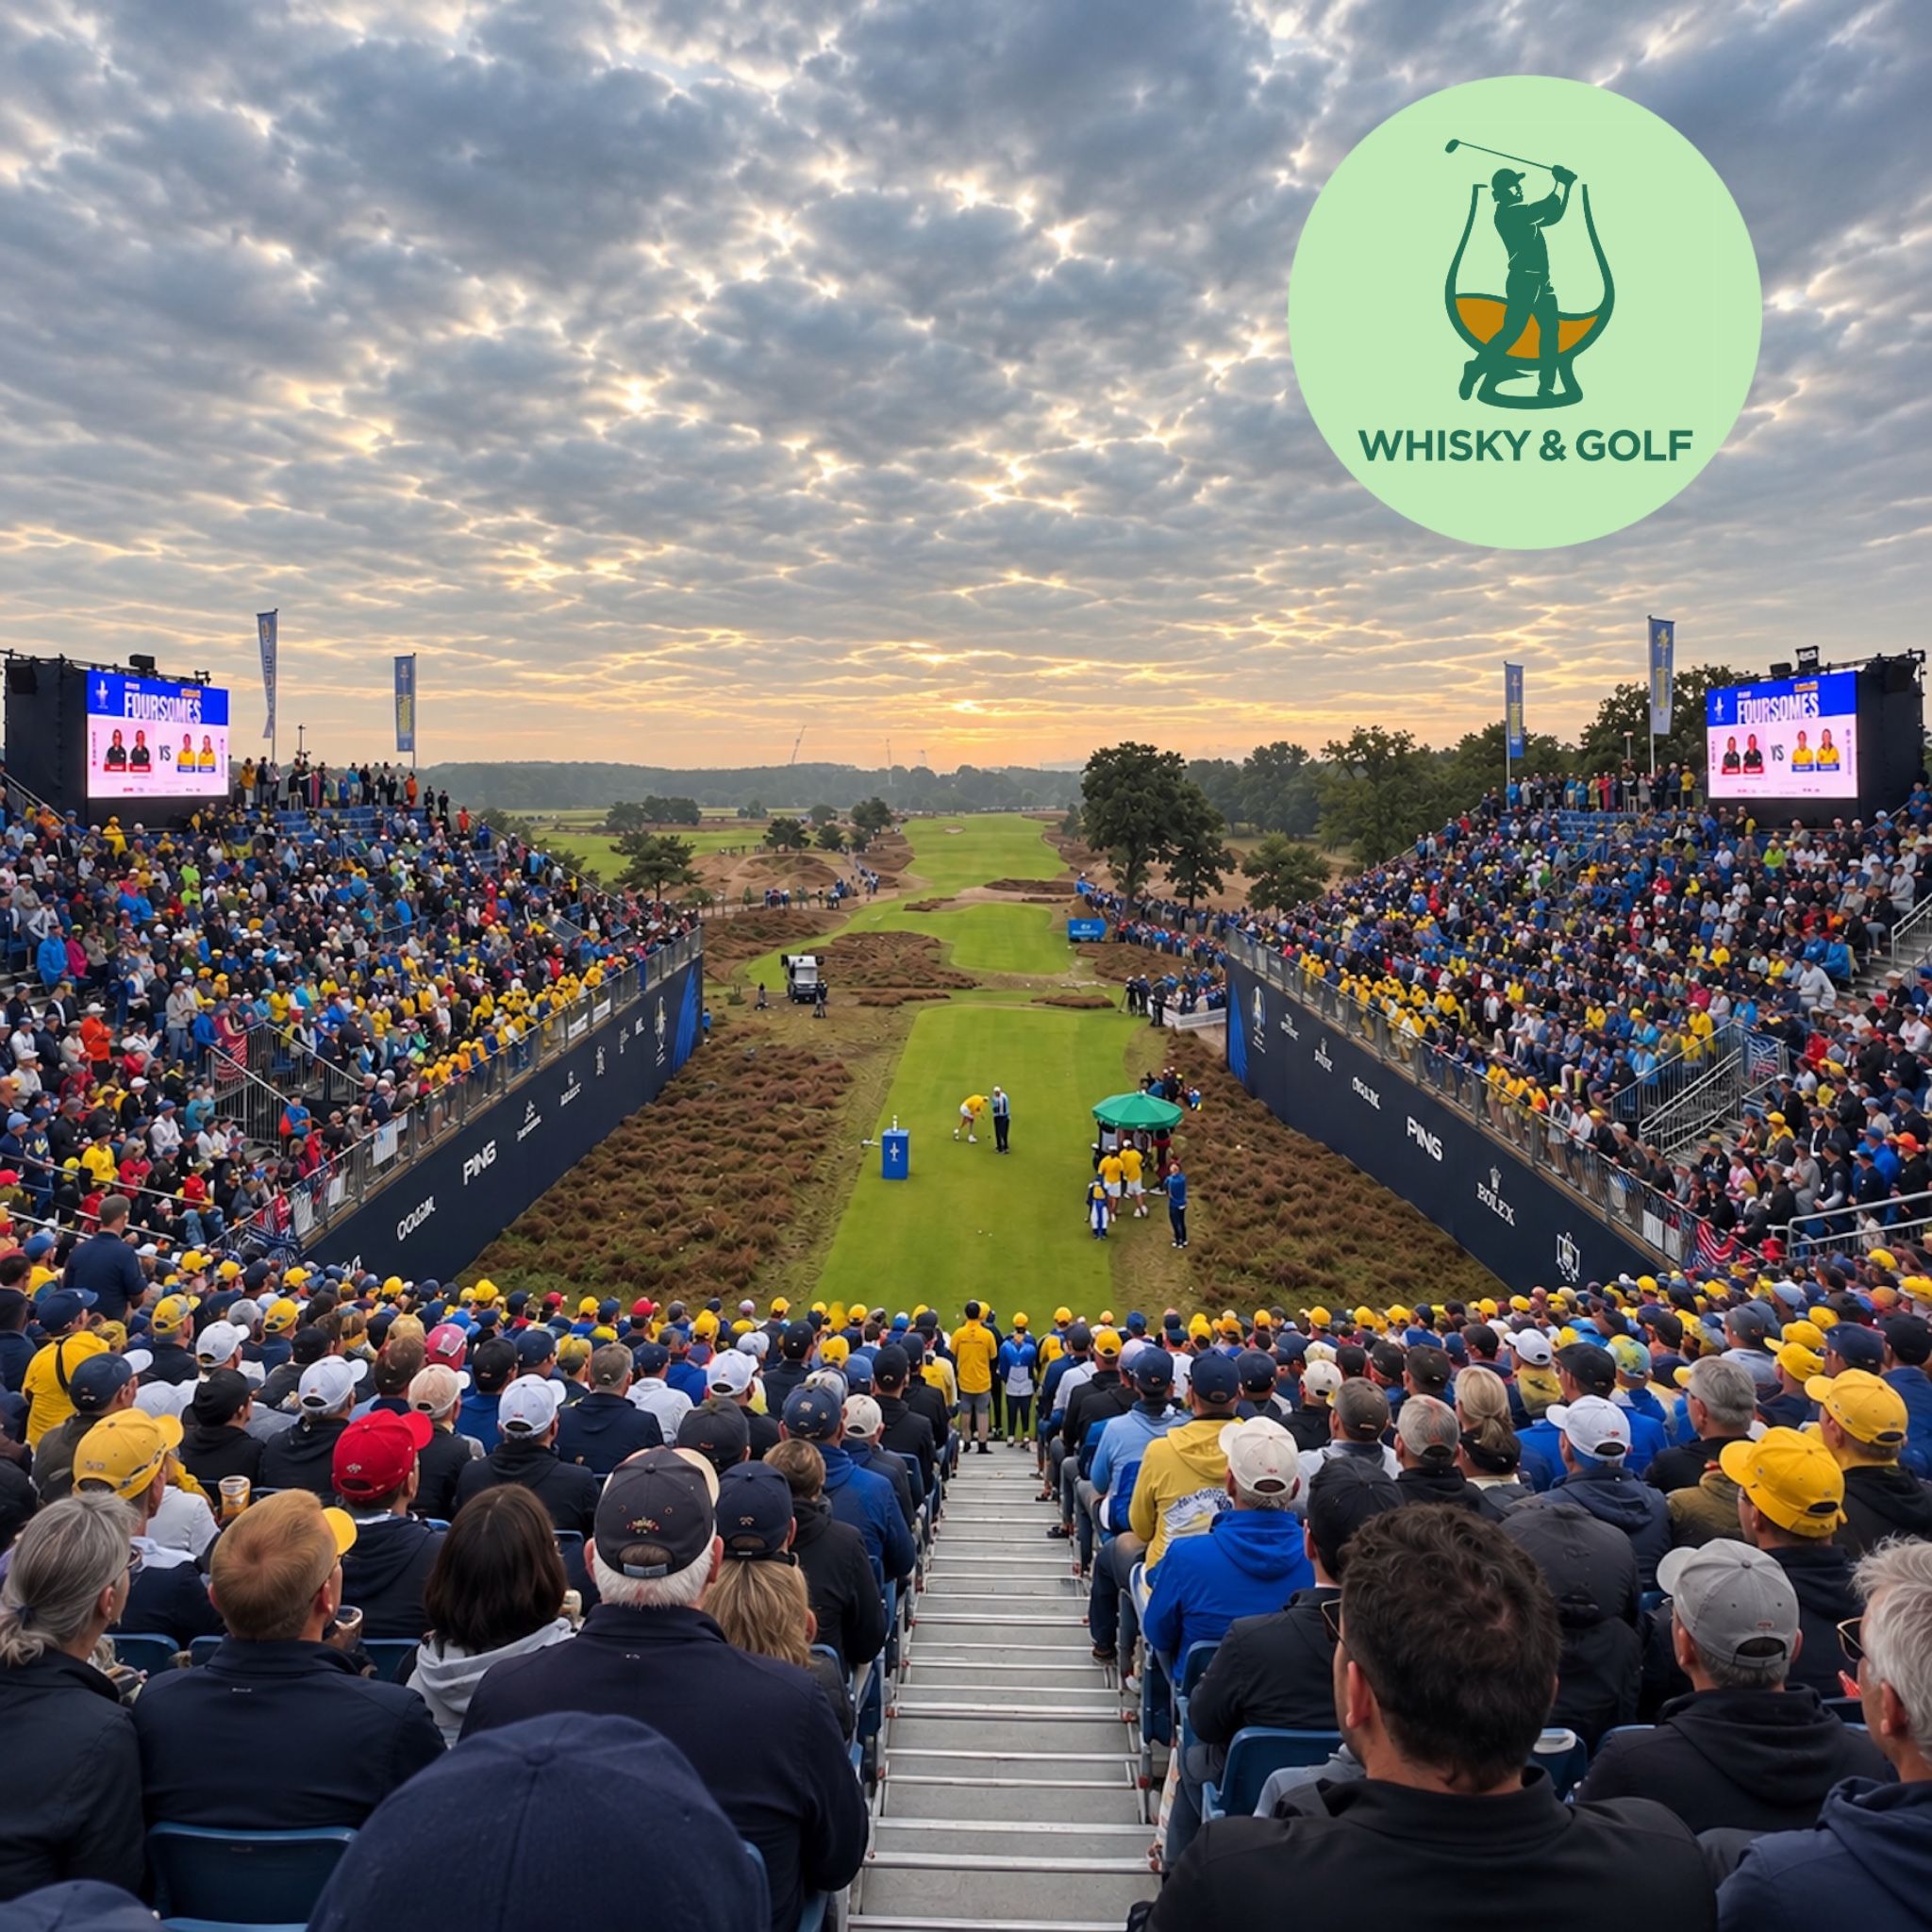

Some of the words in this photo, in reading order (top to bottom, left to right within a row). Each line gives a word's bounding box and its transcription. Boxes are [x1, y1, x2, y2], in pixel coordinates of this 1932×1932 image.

[125, 691, 202, 724] FOURSOMES
[1737, 691, 1821, 725] FOURSOMES
[1407, 1115, 1443, 1162] PING
[462, 1140, 497, 1186] PING
